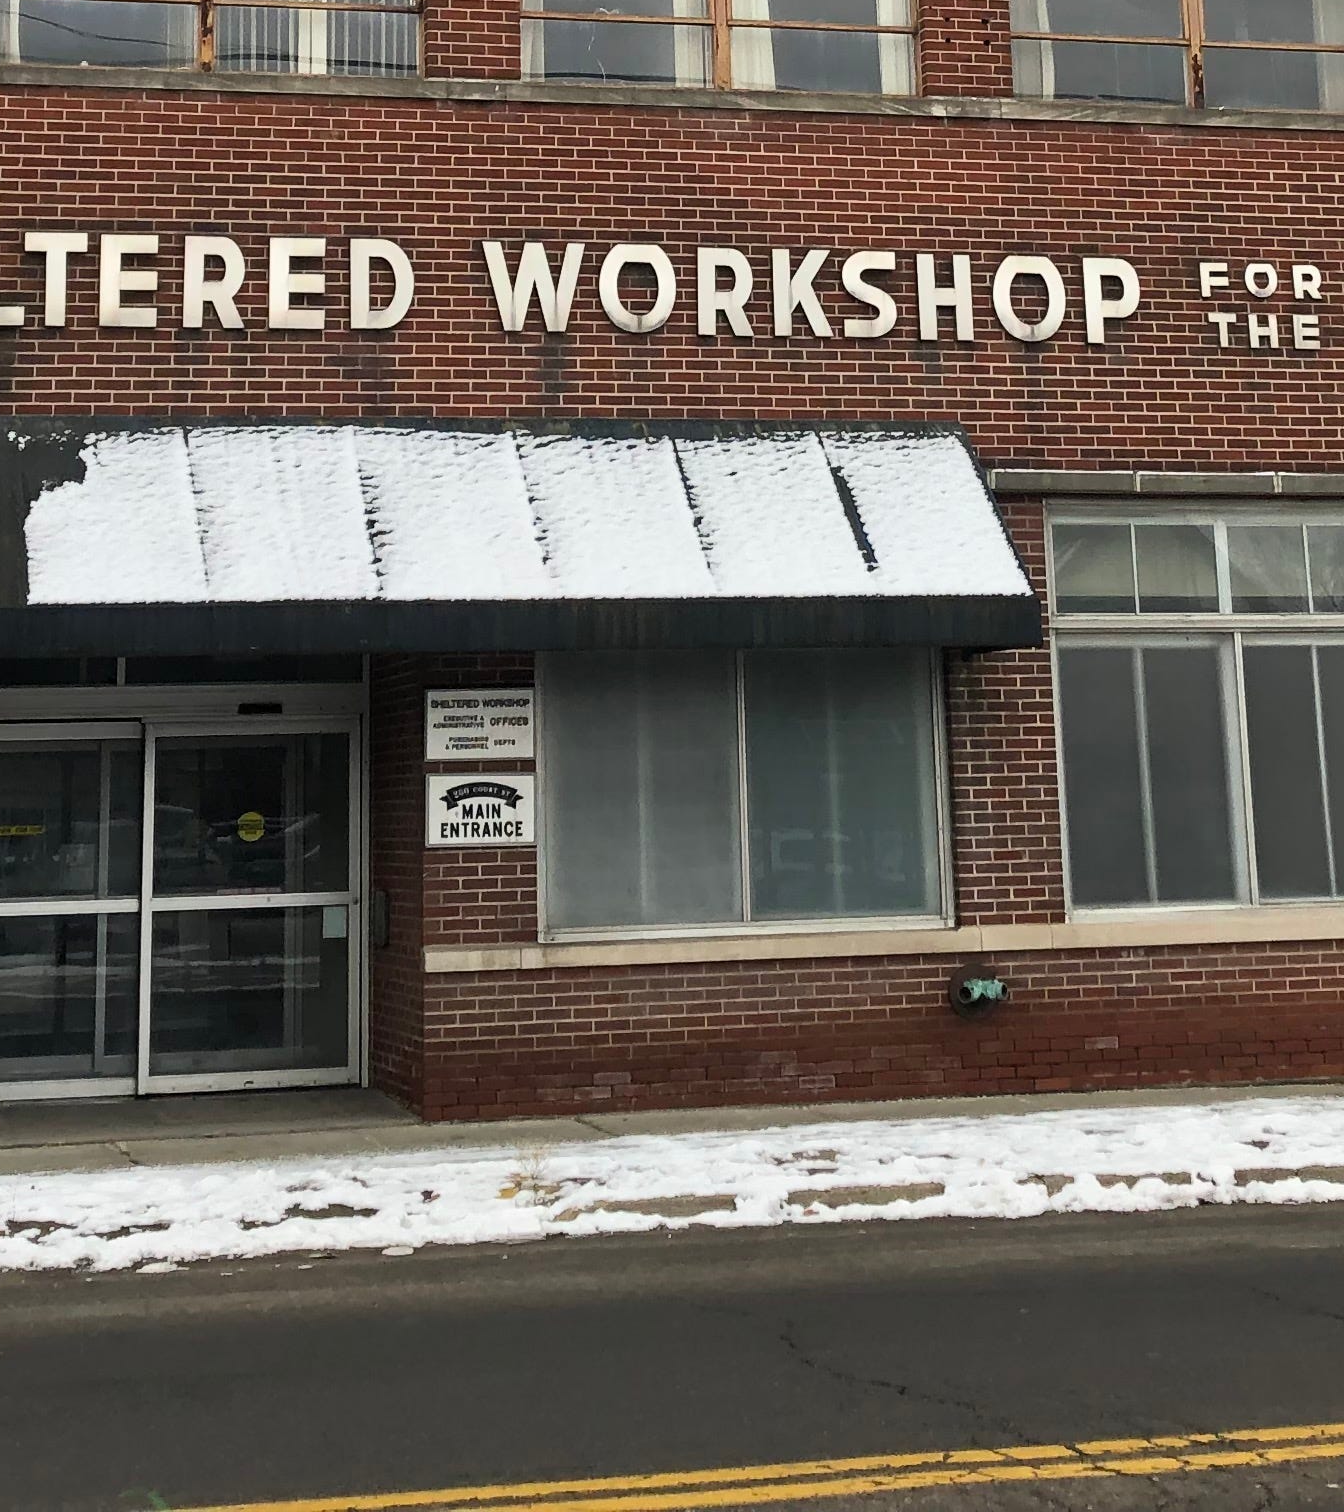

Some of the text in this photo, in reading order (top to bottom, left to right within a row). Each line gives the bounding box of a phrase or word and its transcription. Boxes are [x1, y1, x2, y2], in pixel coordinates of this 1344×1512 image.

[482, 240, 1141, 344] WORKSHOP
[1199, 261, 1322, 300] FOR
[1207, 311, 1322, 350] THE
[431, 698, 530, 709] SHELTERED WORKSHOP
[489, 716, 529, 727] OFFICES
[462, 803, 501, 819] MAIN
[440, 821, 523, 839] ENTRANCE
